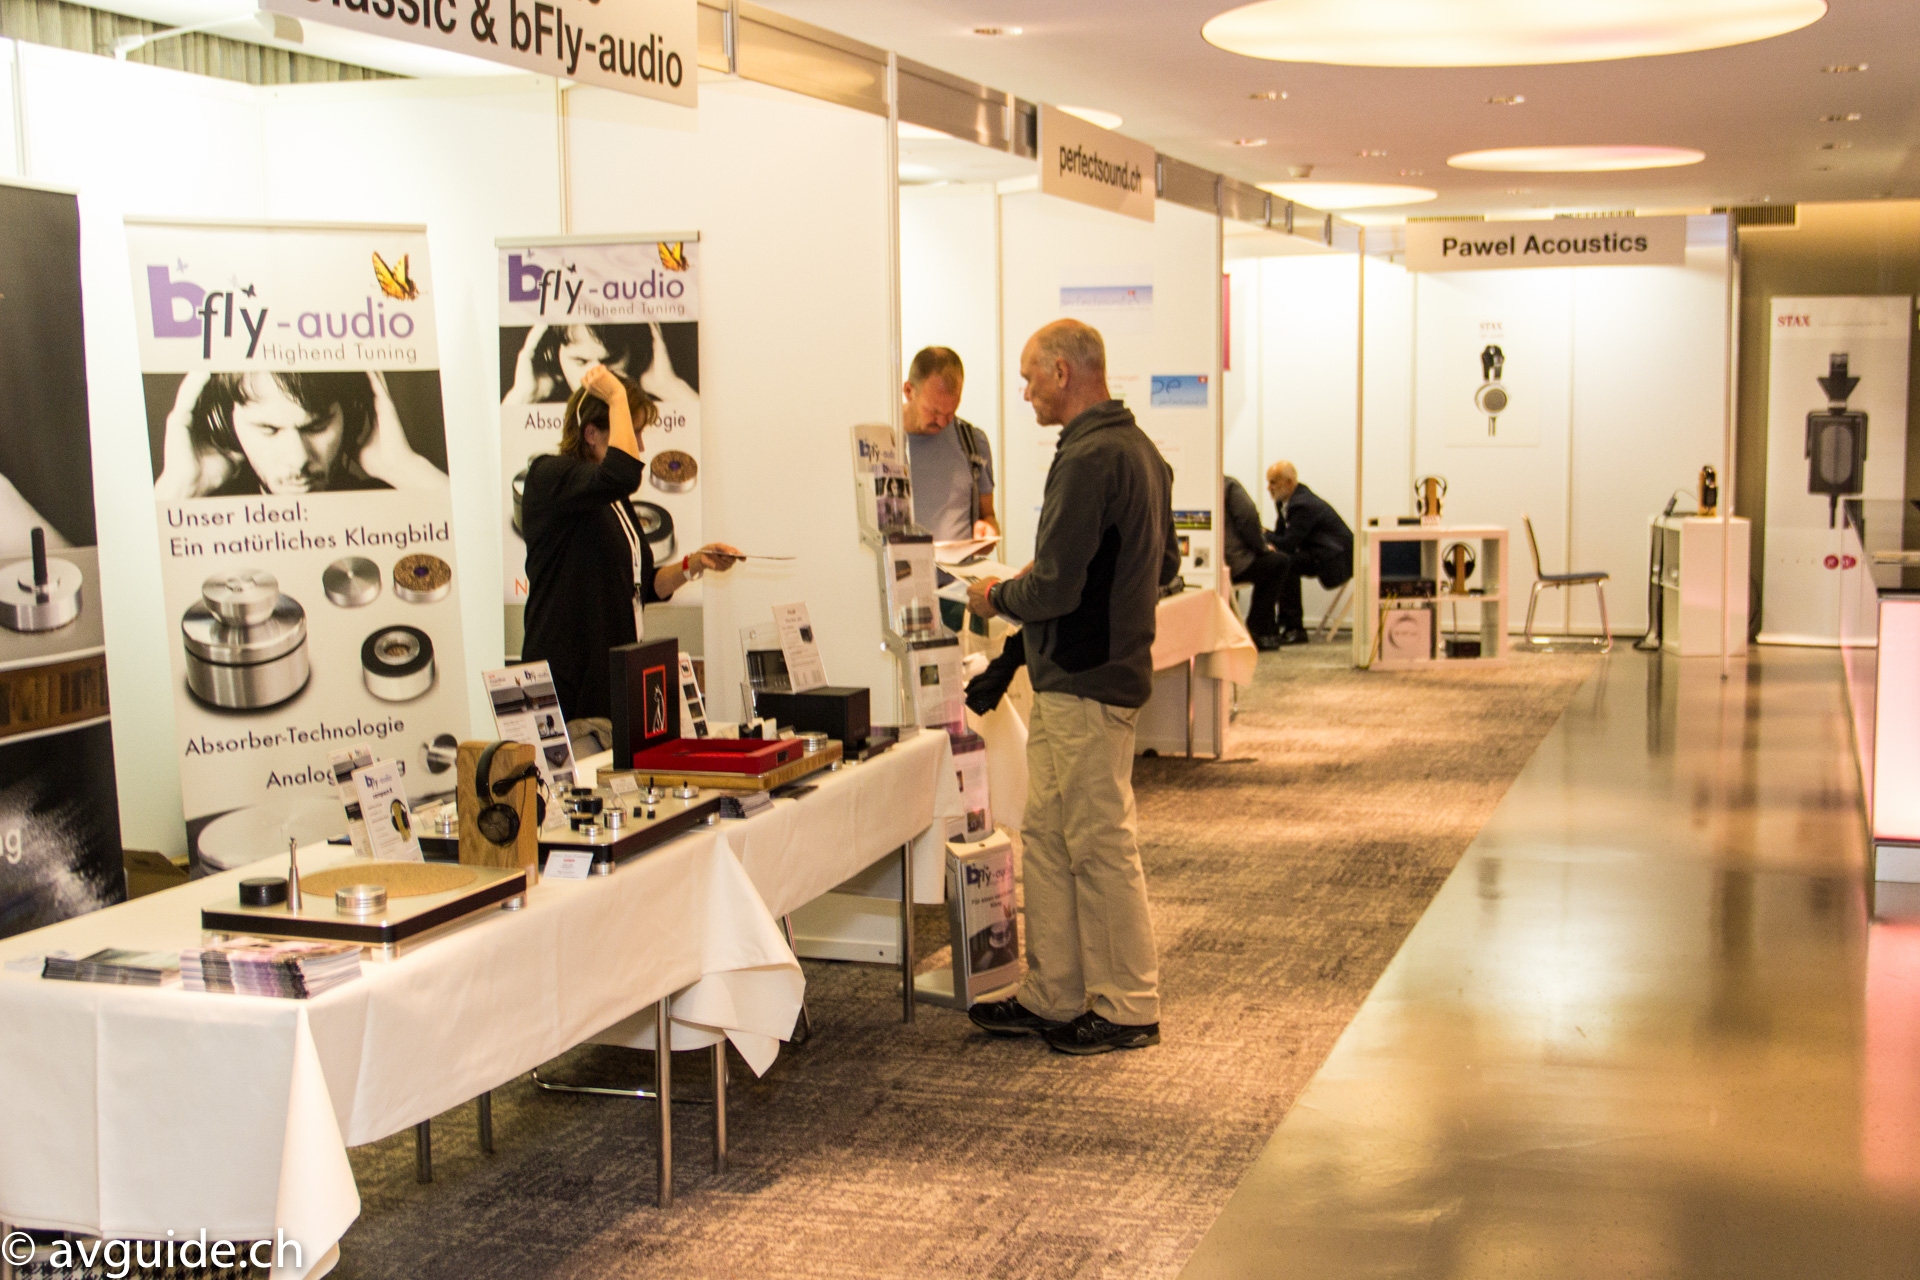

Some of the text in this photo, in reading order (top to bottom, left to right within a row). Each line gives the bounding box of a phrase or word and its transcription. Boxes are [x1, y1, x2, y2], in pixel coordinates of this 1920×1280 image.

[470, 0, 498, 45] &
[510, 0, 684, 88] bFly-audio
[1059, 144, 1142, 194] perfectsound.ch
[1442, 233, 1648, 257] Pawel Acoustics
[1778, 314, 1811, 328] STAX
[263, 342, 417, 365] Highend Tuning
[167, 501, 309, 528] Unser Ideal:
[170, 521, 450, 557] Ein natürliches Klangbild
[185, 716, 406, 757] Absorber-Technologie
